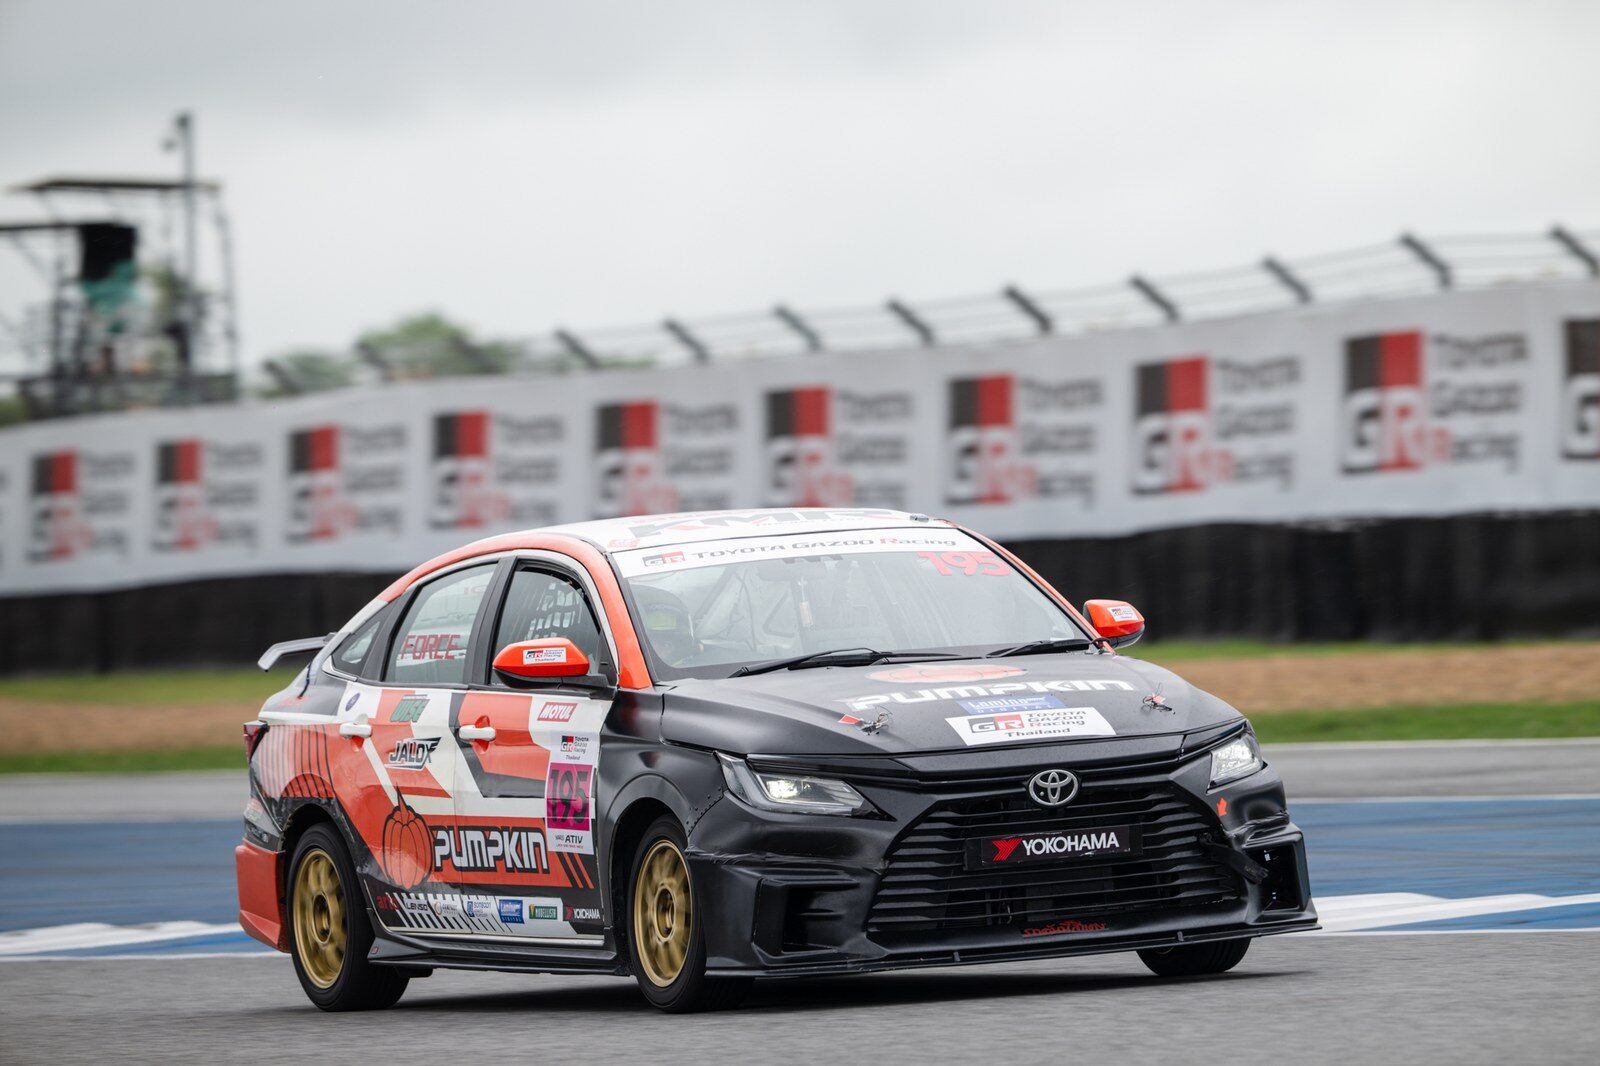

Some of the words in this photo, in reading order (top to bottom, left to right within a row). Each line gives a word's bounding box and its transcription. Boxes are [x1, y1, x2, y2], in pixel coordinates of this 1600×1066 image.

[692, 544, 786, 559] TOYOTA
[792, 539, 874, 550] GAZOO
[879, 538, 957, 548] Racing
[918, 551, 1011, 576] 195
[400, 634, 461, 659] FORCE
[849, 679, 1134, 711] PUMPKIN
[541, 704, 575, 720] MOTUL
[1025, 710, 1087, 718] TOYOTA
[1025, 715, 1085, 723] GAZOO
[970, 717, 1025, 733] GR
[1028, 719, 1086, 729] Racing
[1004, 727, 1071, 738] Thailand
[550, 769, 588, 823] 195
[565, 834, 583, 845] ATIV
[1022, 832, 1120, 856] YOKOHAMA
[434, 829, 549, 871] PUMPKIN
[406, 902, 429, 912] LENSO
[573, 908, 601, 919] YOKOHAMA
